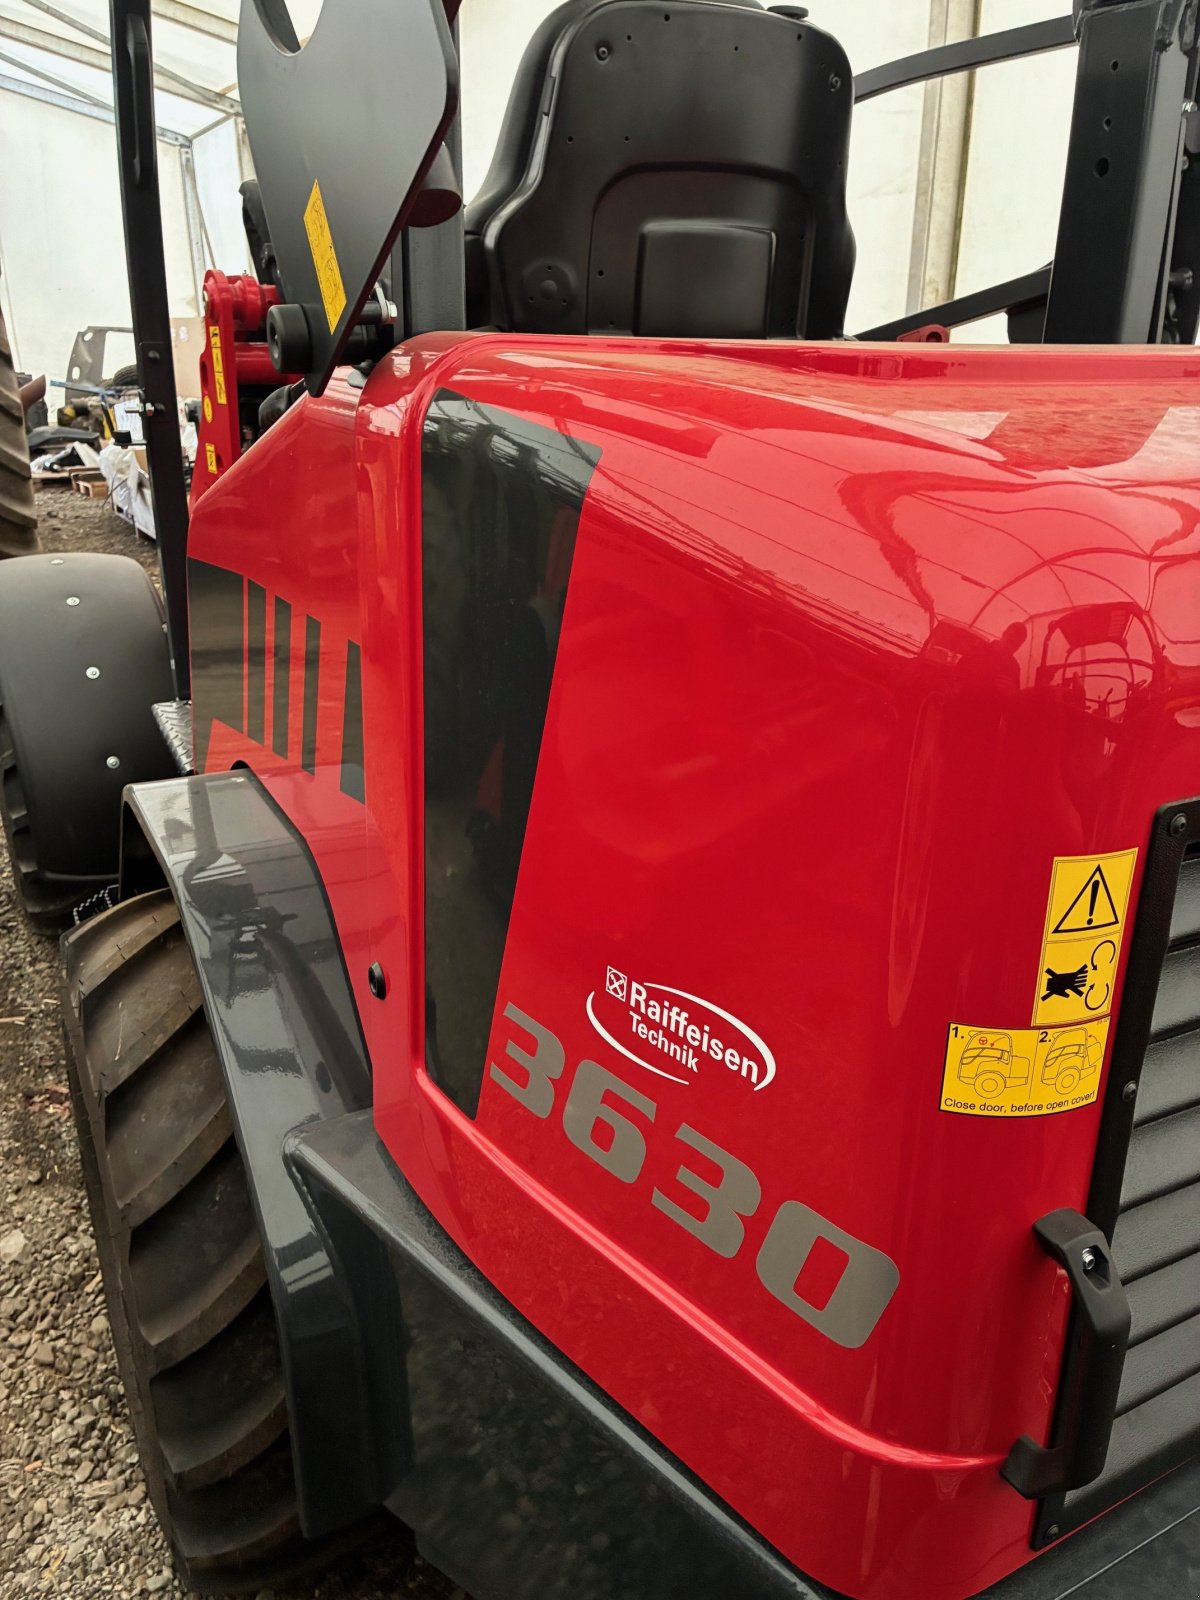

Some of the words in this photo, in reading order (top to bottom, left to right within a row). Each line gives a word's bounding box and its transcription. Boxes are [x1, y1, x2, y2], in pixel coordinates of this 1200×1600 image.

[629, 981, 759, 1084] Raiffeisen
[629, 1011, 699, 1073] Technik
[951, 1026, 965, 1039] 1.
[1039, 1031, 1051, 1043] 2.
[944, 1097, 976, 1110] Close
[979, 1102, 1007, 1113] door,
[1010, 1103, 1044, 1112] before
[1046, 1100, 1069, 1111] open
[1071, 1090, 1095, 1104] cover!
[490, 1001, 900, 1348] 3630
